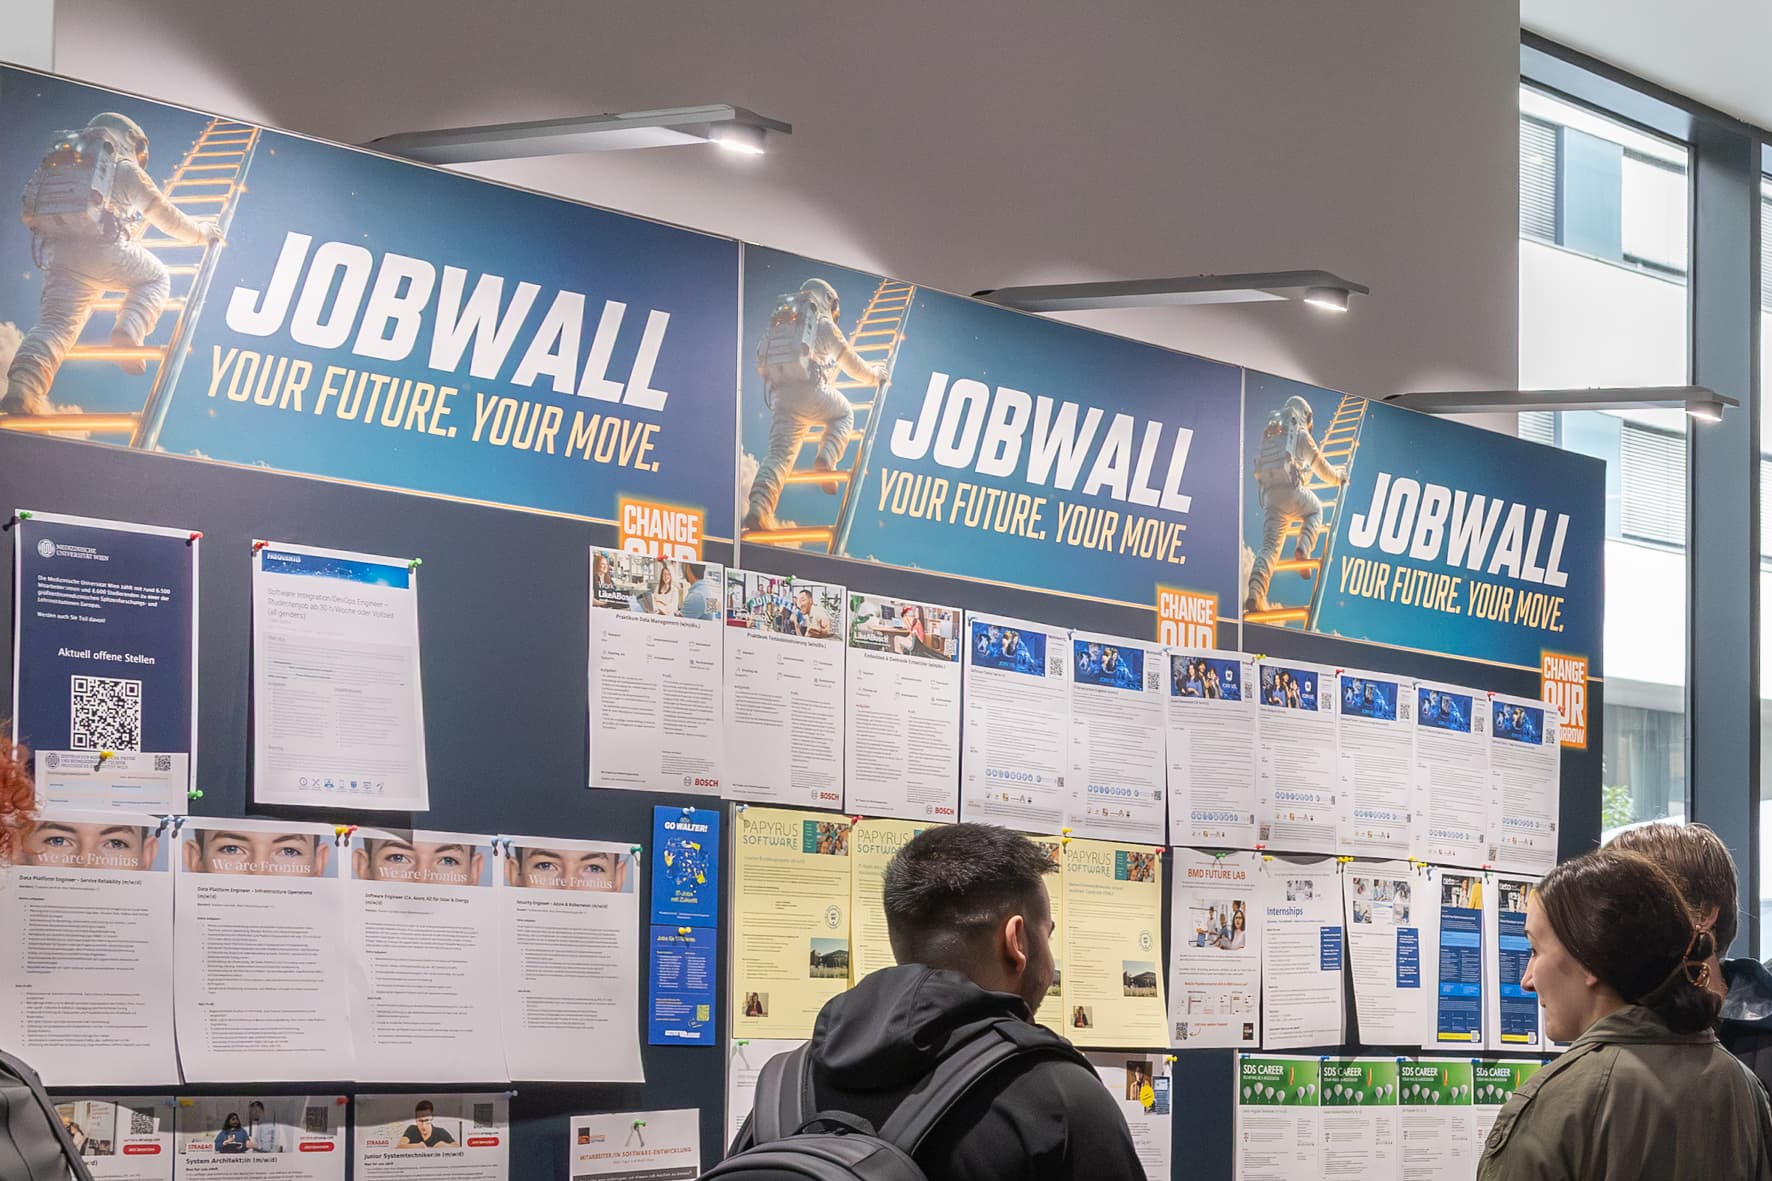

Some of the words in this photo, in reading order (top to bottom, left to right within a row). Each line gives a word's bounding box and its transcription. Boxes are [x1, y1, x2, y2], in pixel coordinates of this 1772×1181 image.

[226, 231, 671, 412] JOBWALL
[207, 345, 314, 412] YOUR
[314, 365, 458, 438] FUTURE.
[471, 393, 564, 455] YOUR
[565, 411, 661, 473] MOVE.
[890, 371, 1194, 514] JOBWALL
[878, 467, 949, 522] YOUR
[949, 482, 1047, 540] FUTURE.
[1056, 501, 1119, 552] YOUR
[1119, 514, 1187, 564] MOVE.
[623, 504, 699, 545] CHANGE
[1348, 472, 1570, 588] JOBWALL
[1339, 555, 1390, 601] YOUR
[1390, 566, 1461, 614] FUTURE.
[1467, 580, 1514, 623] YOUR
[1514, 590, 1565, 633] MOVE.
[1160, 592, 1214, 625] CHANGE
[58, 647, 91, 660] Aktuell
[93, 650, 123, 662] offene
[124, 653, 156, 665] Stellen
[1544, 656, 1584, 684] CHANGE
[694, 777, 719, 788] BOSCH
[820, 791, 840, 801] BOSCH
[934, 806, 954, 816] BOSCH
[664, 821, 676, 830] GO
[743, 819, 798, 837] PAPYRUS
[743, 834, 798, 850] SOFTWARE
[857, 829, 909, 846] PAPYRUS
[857, 843, 900, 856] SOFTWA
[1066, 848, 1111, 865] PAPYRUS
[38, 852, 59, 864] We
[62, 854, 84, 865] are
[86, 852, 139, 867] Fronius
[212, 858, 232, 871] We
[235, 860, 257, 872] are
[260, 860, 311, 873] Fronius
[379, 867, 398, 878] We
[400, 869, 421, 880] are
[423, 868, 468, 882] Fronius
[1067, 863, 1111, 878] SOFTWARE
[1187, 868, 1204, 878] BMD
[1205, 869, 1231, 879] FUTURE
[1232, 870, 1246, 880] LAB
[528, 874, 548, 885] We
[551, 877, 567, 887] are
[570, 876, 613, 889] Fronius
[1266, 906, 1303, 918] Internships
[1242, 1064, 1257, 1075] SDS
[1257, 1065, 1284, 1076] CAREER
[1323, 1067, 1337, 1077] SDS
[1337, 1067, 1362, 1077] CAREER
[1402, 1066, 1414, 1076] SDS
[1415, 1067, 1438, 1077] CAREER
[1489, 1067, 1511, 1077] CAREER
[186, 1157, 210, 1165] System
[364, 1152, 382, 1161] Junior
